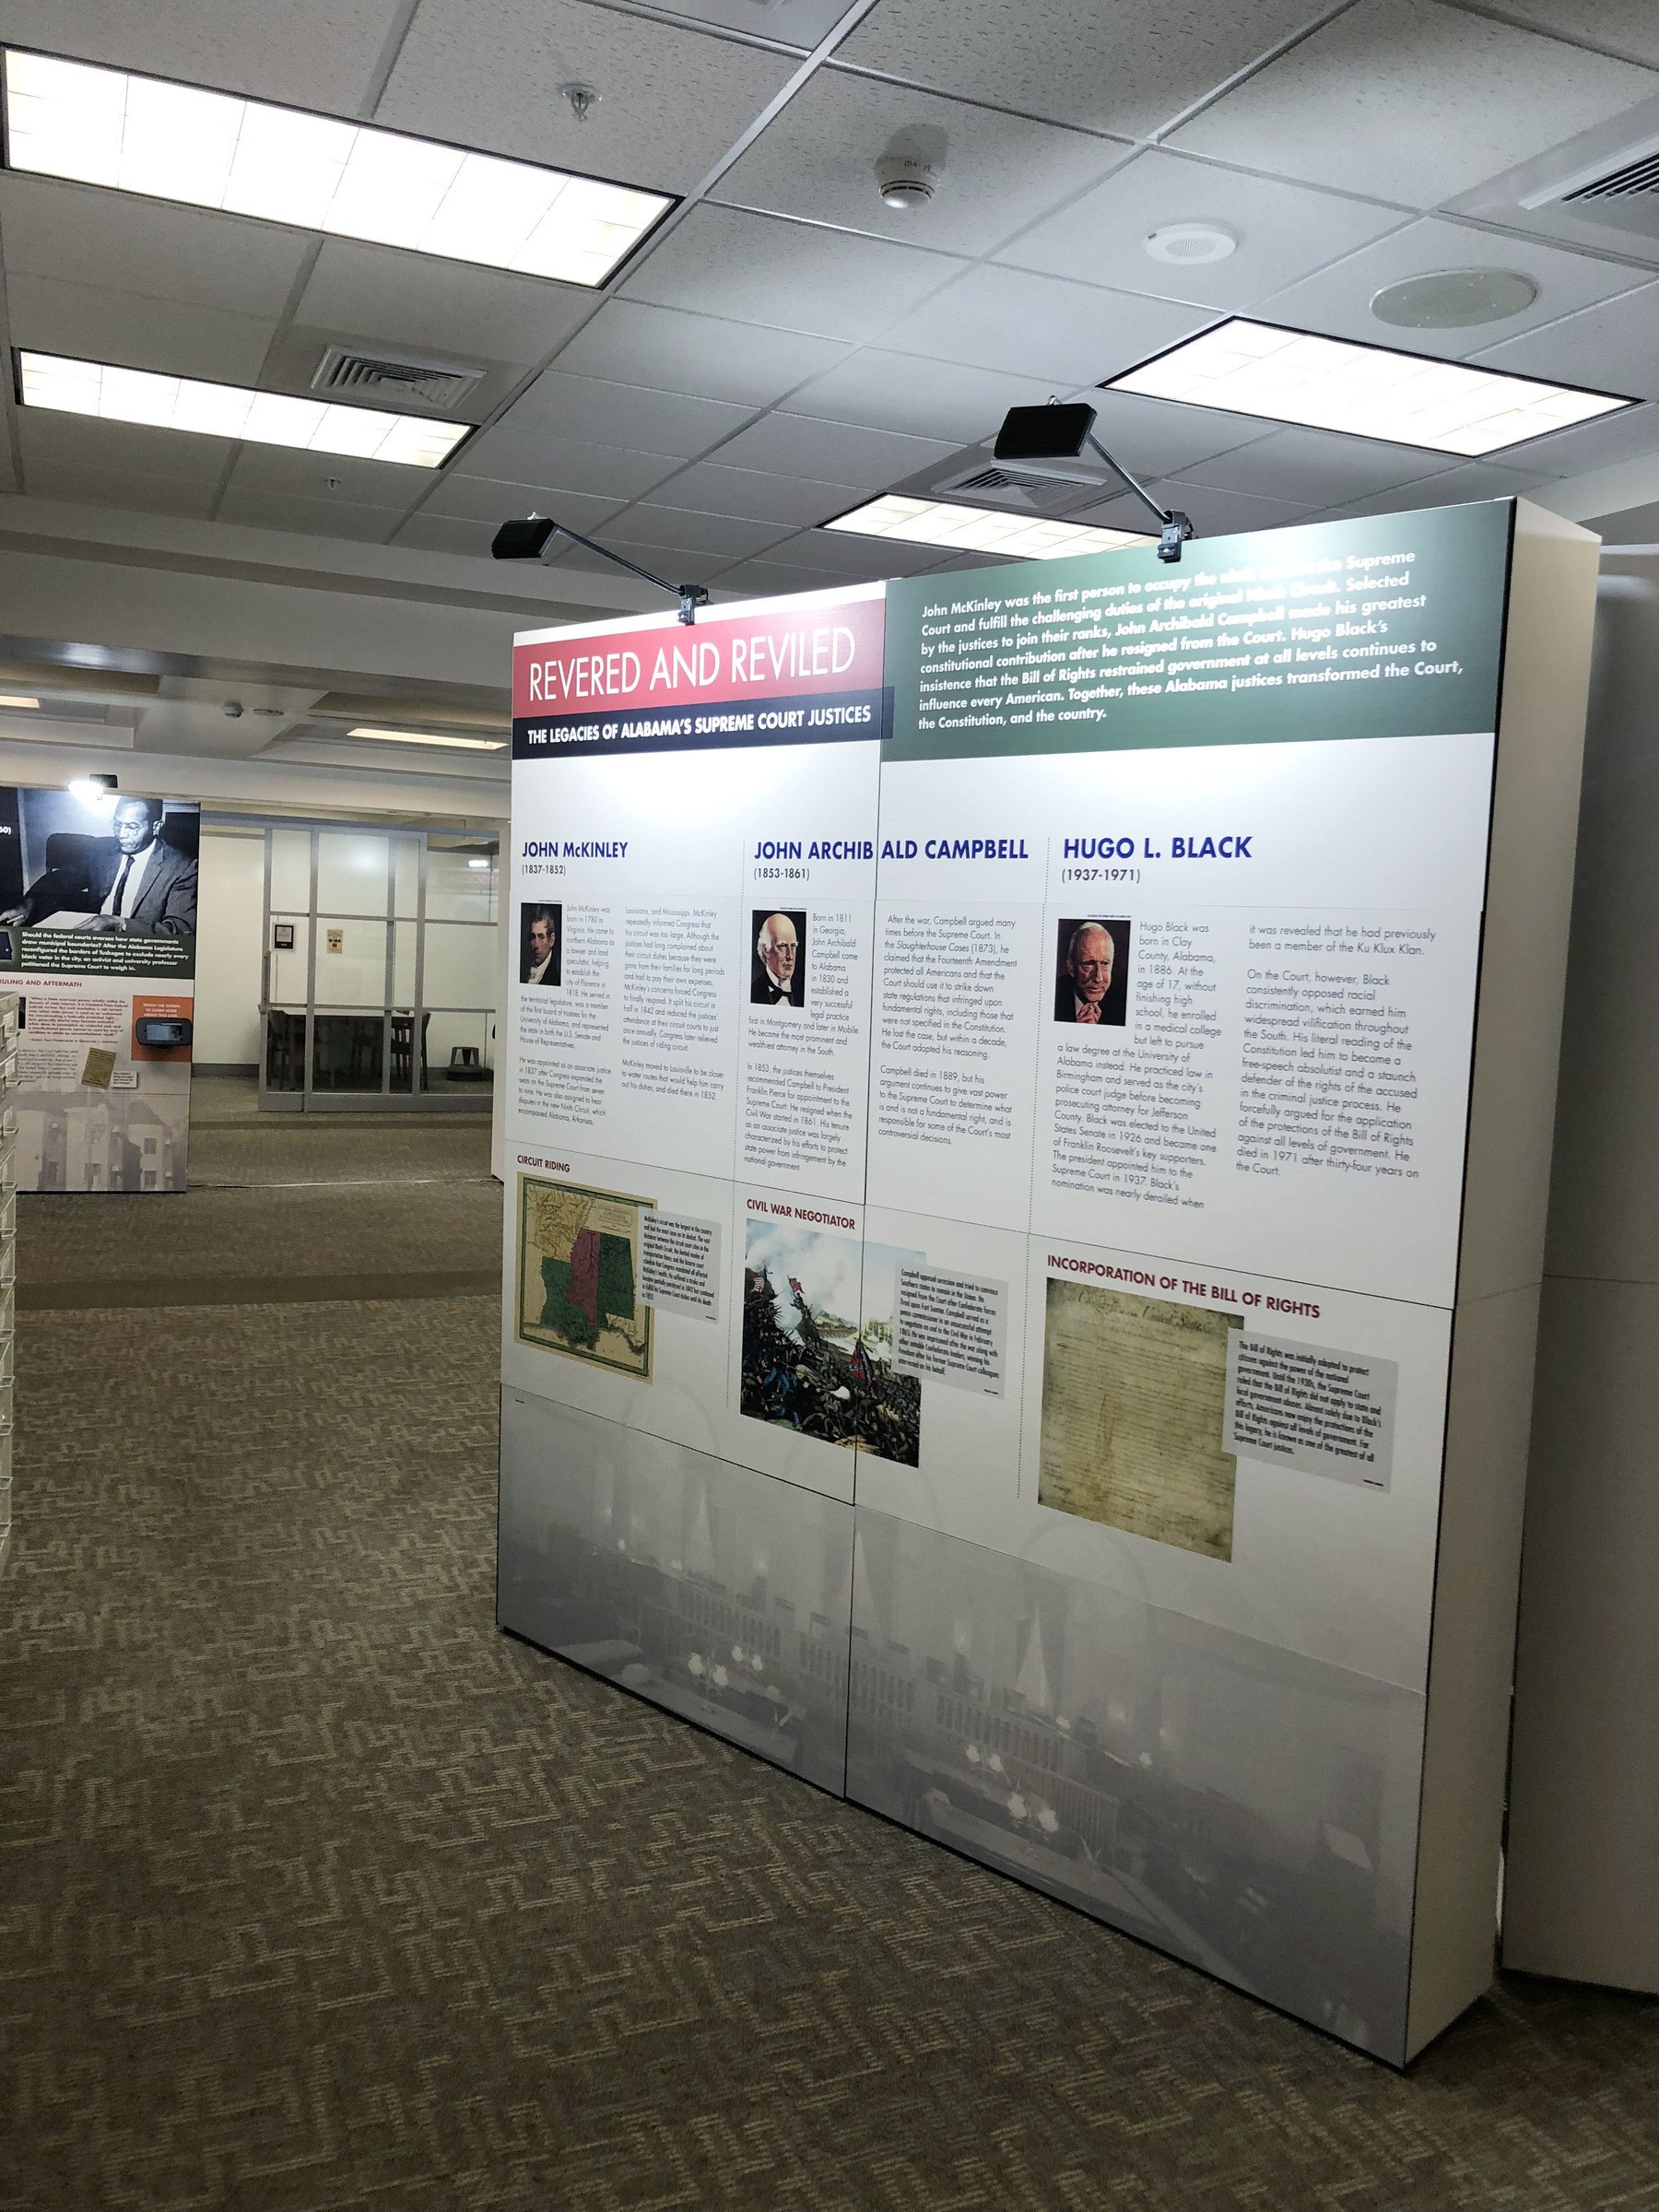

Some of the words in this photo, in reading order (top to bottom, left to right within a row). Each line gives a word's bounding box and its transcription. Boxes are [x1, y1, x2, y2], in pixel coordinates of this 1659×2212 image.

[922, 603, 947, 618] John
[950, 597, 1002, 614] McKinley
[1004, 597, 1029, 608] was
[1031, 592, 1052, 606] the
[1053, 588, 1078, 603] first
[1081, 586, 1124, 603] person
[1127, 582, 1141, 594] to
[1144, 579, 1191, 593] occupy
[1194, 573, 1218, 587] the
[1346, 555, 1416, 572] Supreme
[921, 621, 950, 636] Court
[953, 618, 975, 633] and
[978, 616, 1006, 630] fulfill
[1010, 614, 1029, 628] the
[1031, 607, 1101, 625] challenging
[1104, 603, 1143, 618] duties
[1146, 600, 1159, 614] of
[1163, 598, 1185, 612] the
[1188, 592, 1242, 611] original
[1345, 575, 1408, 594] Selected
[921, 641, 935, 657] by
[937, 639, 955, 653] the
[958, 636, 998, 654] justices
[1001, 634, 1014, 647] to
[1016, 631, 1039, 649] join
[1041, 629, 1070, 643] their
[1072, 625, 1112, 641] ranks,
[1114, 622, 1147, 636] John
[1148, 615, 1214, 633] Archibald
[1217, 608, 1285, 628] Campbell
[1288, 605, 1331, 620] made
[1335, 603, 1357, 617] his
[1360, 595, 1425, 618] greatest
[920, 654, 993, 673] constitutional
[995, 649, 1065, 666] contribution
[1068, 646, 1100, 660] after
[1101, 644, 1118, 658] he
[1120, 639, 1178, 657] resigned
[1179, 638, 1215, 652] from
[1216, 634, 1241, 648] the
[1241, 630, 1288, 646] Court.
[1289, 629, 1332, 644] Hugo
[1334, 622, 1388, 639] Black's
[530, 651, 641, 701] REVERED
[649, 642, 719, 690] AND
[732, 626, 855, 684] REVILED
[920, 677, 971, 691] insistence
[974, 673, 997, 688] that
[1000, 672, 1018, 685] the
[1021, 669, 1040, 683] Bill
[1042, 668, 1055, 682] of
[1058, 665, 1096, 683] Rights
[1099, 660, 1164, 677] restrained
[1167, 653, 1251, 676] government
[1253, 652, 1270, 665] at
[1272, 650, 1291, 664] all
[1295, 647, 1338, 662] levels
[1342, 642, 1416, 658] continues
[1420, 639, 1437, 653] to
[919, 697, 967, 711] influence
[970, 696, 1002, 709] every
[1005, 689, 1065, 704] American.
[1069, 686, 1124, 703] Together,
[1126, 683, 1162, 697] these
[1164, 679, 1228, 694] Alabama
[1230, 676, 1283, 693] justices
[1286, 667, 1381, 686] transformed
[1383, 666, 1410, 679] the
[1413, 662, 1464, 677] Court,
[528, 729, 547, 744] THE
[550, 725, 600, 744] LEGACIES
[603, 725, 619, 740] OF
[621, 719, 692, 739] ALABAMA'S
[696, 713, 754, 734] SUPREME
[758, 710, 805, 731] COURT
[808, 705, 871, 727] JUSTICES
[918, 715, 935, 729] the
[937, 712, 1006, 728] Constitution,
[1009, 711, 1032, 724] and
[1035, 710, 1055, 723] the
[1057, 707, 1107, 723] country.
[522, 841, 558, 857] JOHN
[562, 841, 629, 857] McKINLEY
[754, 841, 801, 859] JOHN
[924, 840, 1029, 859] CAMPBELL
[1064, 837, 1134, 859] HUGO
[1144, 837, 1160, 858] L.
[1171, 837, 1251, 858] BLACK
[522, 865, 566, 877] (1837-1852)
[754, 867, 810, 881] (1853-1861)
[1061, 868, 1141, 884] (1937-1971)
[566, 904, 577, 912] John
[577, 905, 599, 914] McKinley
[887, 914, 903, 924] After
[904, 914, 915, 924] the
[916, 918, 931, 926] war,
[933, 915, 967, 927] Campbell
[968, 917, 994, 928] argued
[995, 921, 1016, 929] many
[1139, 922, 1163, 935] Hugo
[1165, 922, 1188, 933] Black
[1138, 935, 1158, 946] born
[1161, 936, 1169, 947] in
[1171, 936, 1192, 949] Clay
[1249, 924, 1254, 935] it
[1279, 925, 1321, 936] revealed
[1324, 926, 1342, 937] that
[1346, 927, 1358, 937] he
[1360, 927, 1381, 938] had
[1383, 929, 1435, 943] previously
[1137, 950, 1170, 964] County,
[1172, 951, 1217, 965] Alabama,
[879, 1065, 912, 1078] Campbell
[913, 1068, 928, 1078] died
[930, 1069, 935, 1079] in
[939, 1070, 959, 1084] 1889,
[961, 1073, 972, 1083] but
[974, 1074, 984, 1084] his
[517, 1155, 543, 1169] CIRCUIT
[545, 1159, 571, 1173] RIDING
[747, 1199, 768, 1213] CIVIL
[771, 1203, 792, 1218] WAR
[794, 1207, 855, 1230] NEGOTIATOR
[1047, 1254, 1155, 1287] INCORPORATION
[1159, 1276, 1178, 1290] OF
[1182, 1279, 1206, 1297] THE
[1211, 1286, 1238, 1302] BILL
[1241, 1291, 1261, 1307] OF
[1266, 1295, 1321, 1319] RIGHTS
